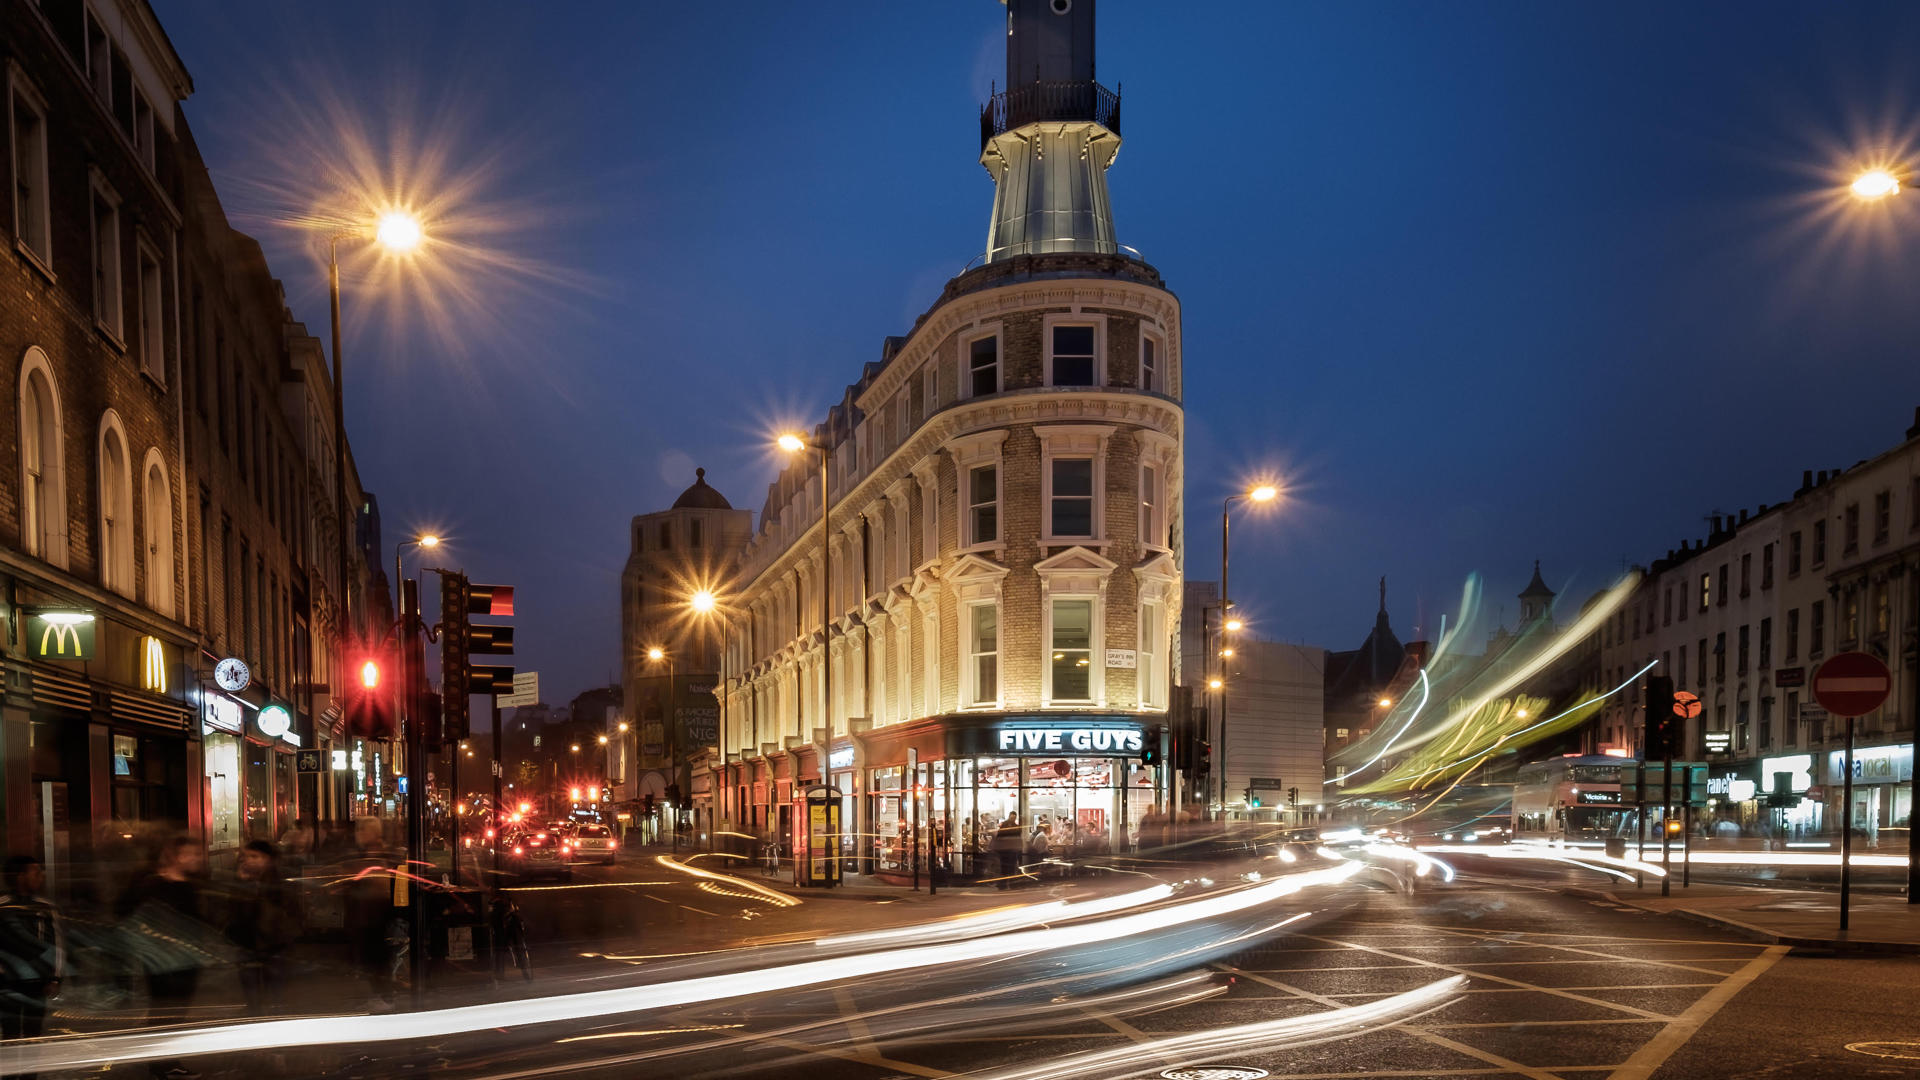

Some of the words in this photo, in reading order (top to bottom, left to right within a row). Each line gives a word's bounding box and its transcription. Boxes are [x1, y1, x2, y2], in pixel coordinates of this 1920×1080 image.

[999, 729, 1062, 750] FIVE
[1071, 729, 1143, 751] GUYS
[1863, 754, 1891, 777] local
